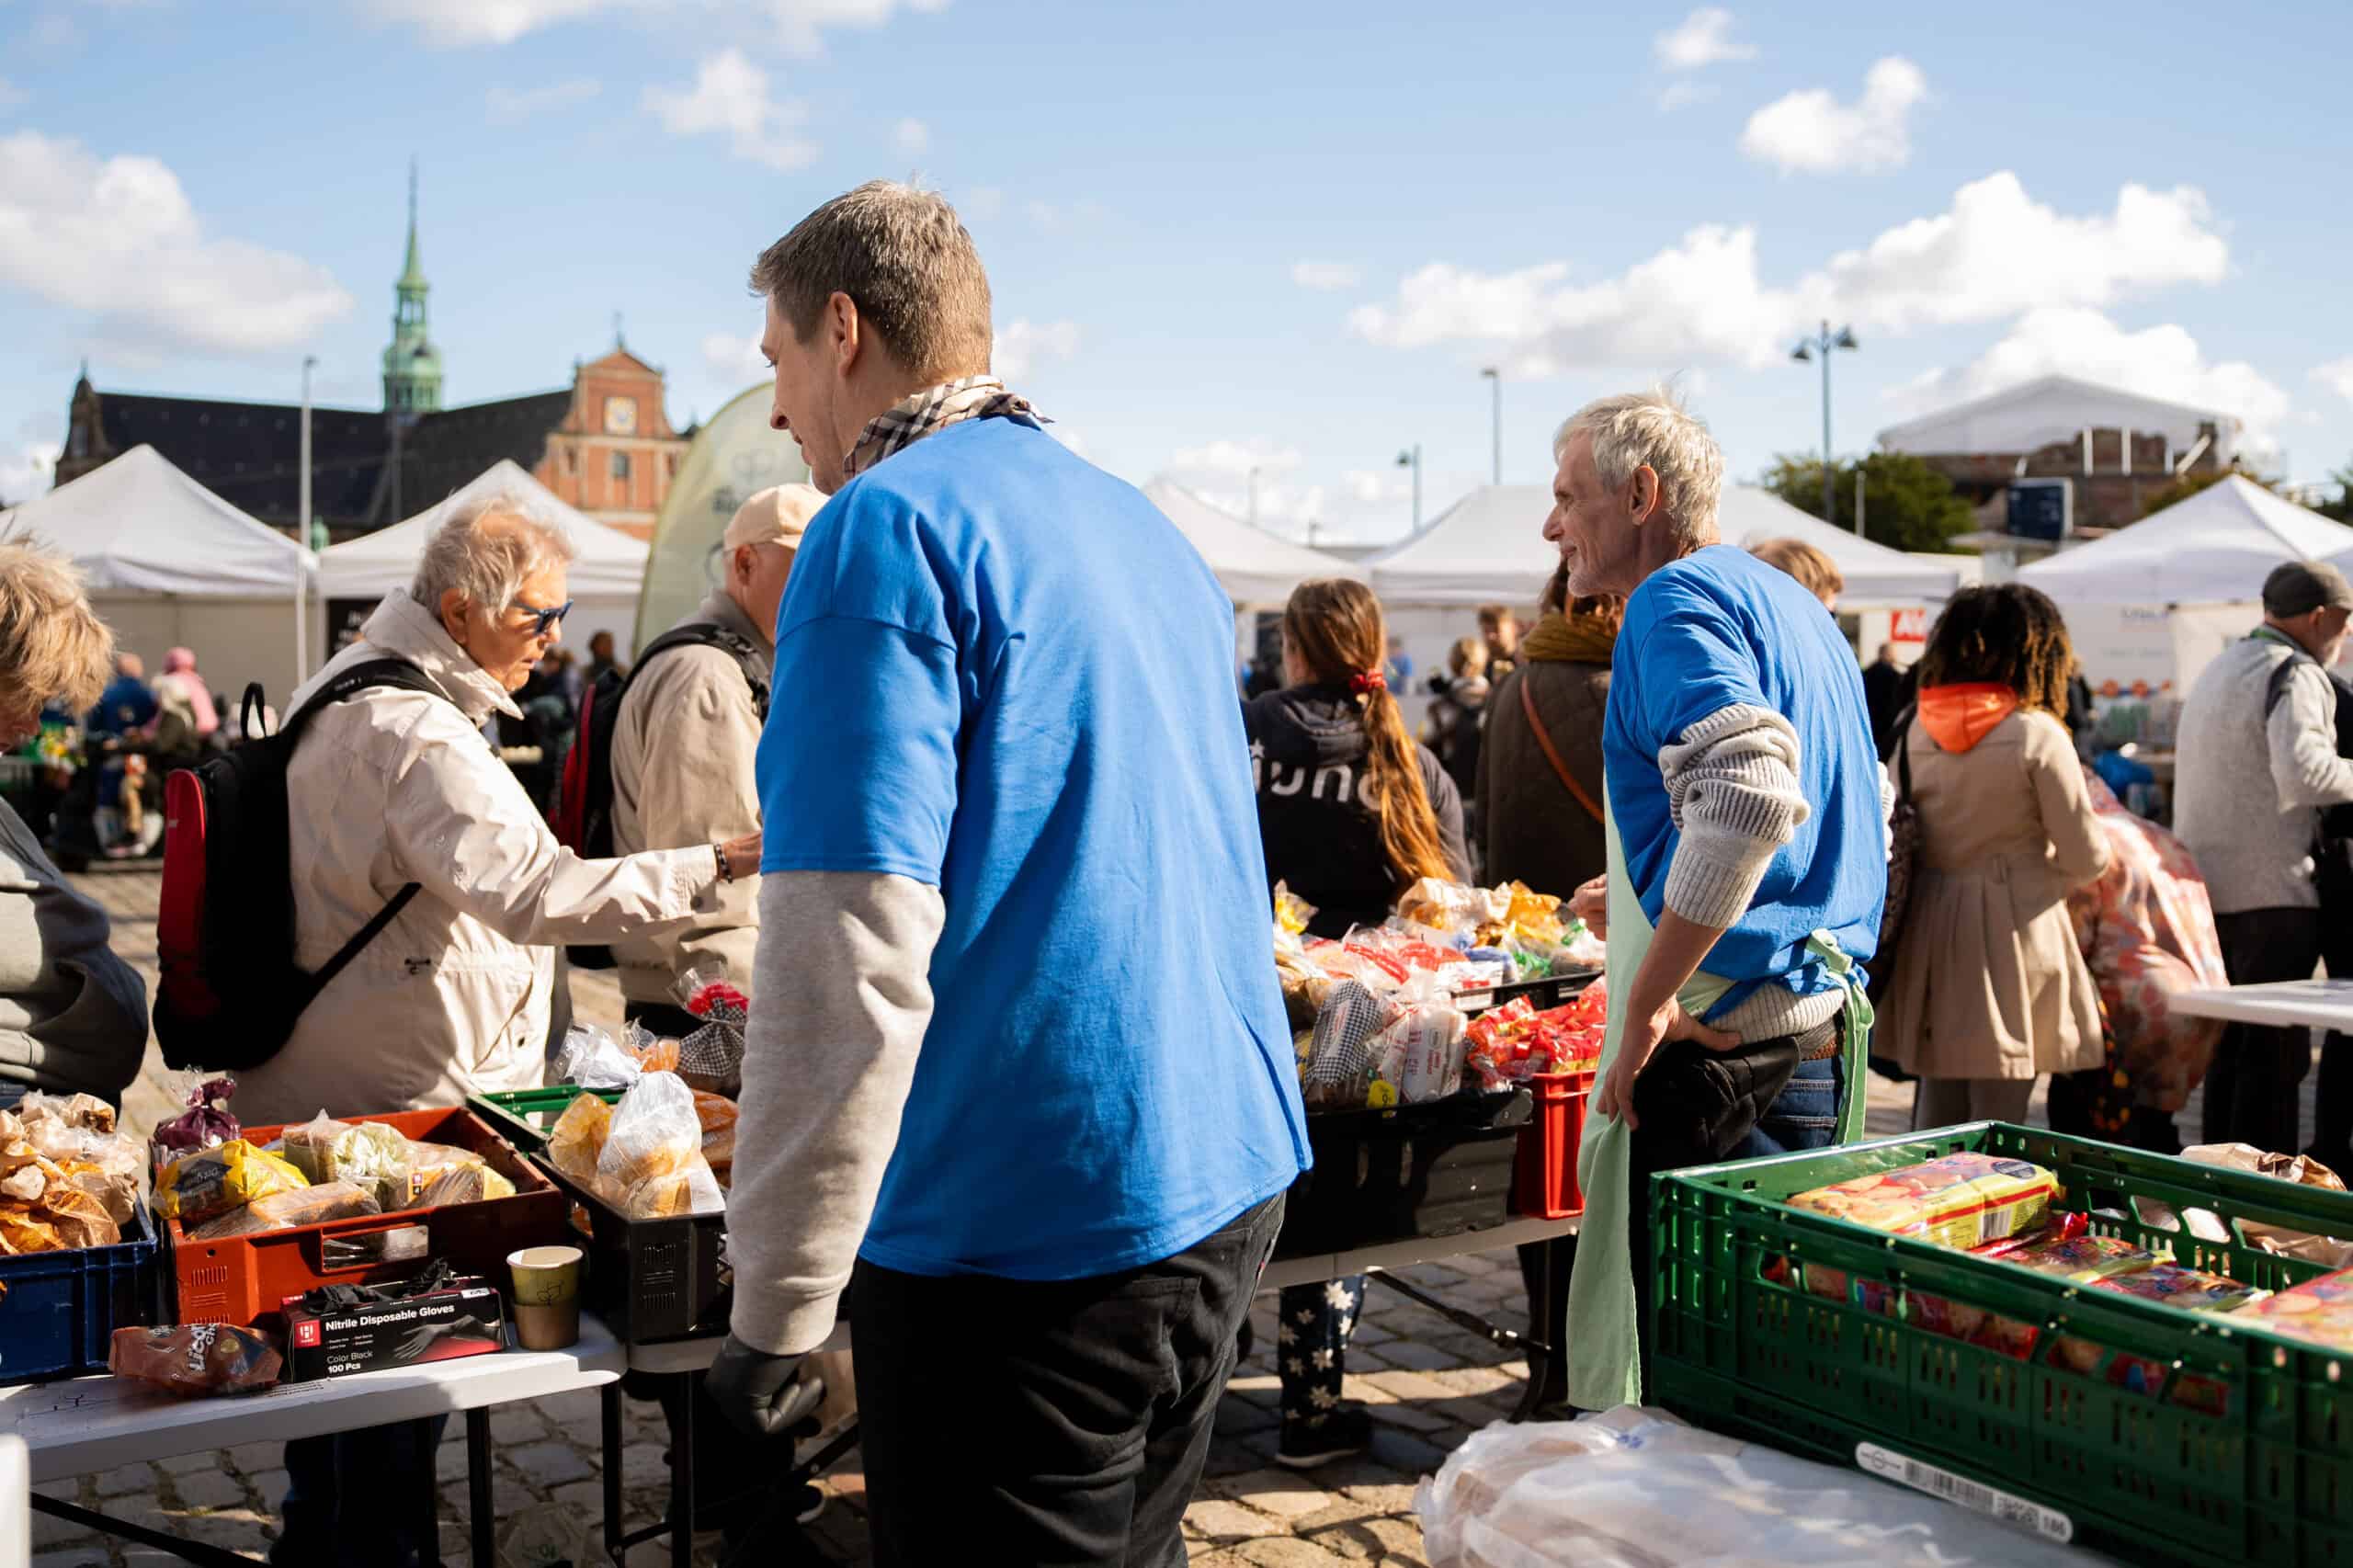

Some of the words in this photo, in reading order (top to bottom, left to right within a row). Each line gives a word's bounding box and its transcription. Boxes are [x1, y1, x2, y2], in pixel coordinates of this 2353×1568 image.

[325, 1318, 358, 1331] Nitrile
[359, 1310, 417, 1325] Disposable
[418, 1304, 455, 1317] Gloves
[326, 1355, 349, 1364] Color
[351, 1351, 373, 1360] Black
[327, 1365, 345, 1373] 100
[346, 1362, 361, 1370] Pcs
